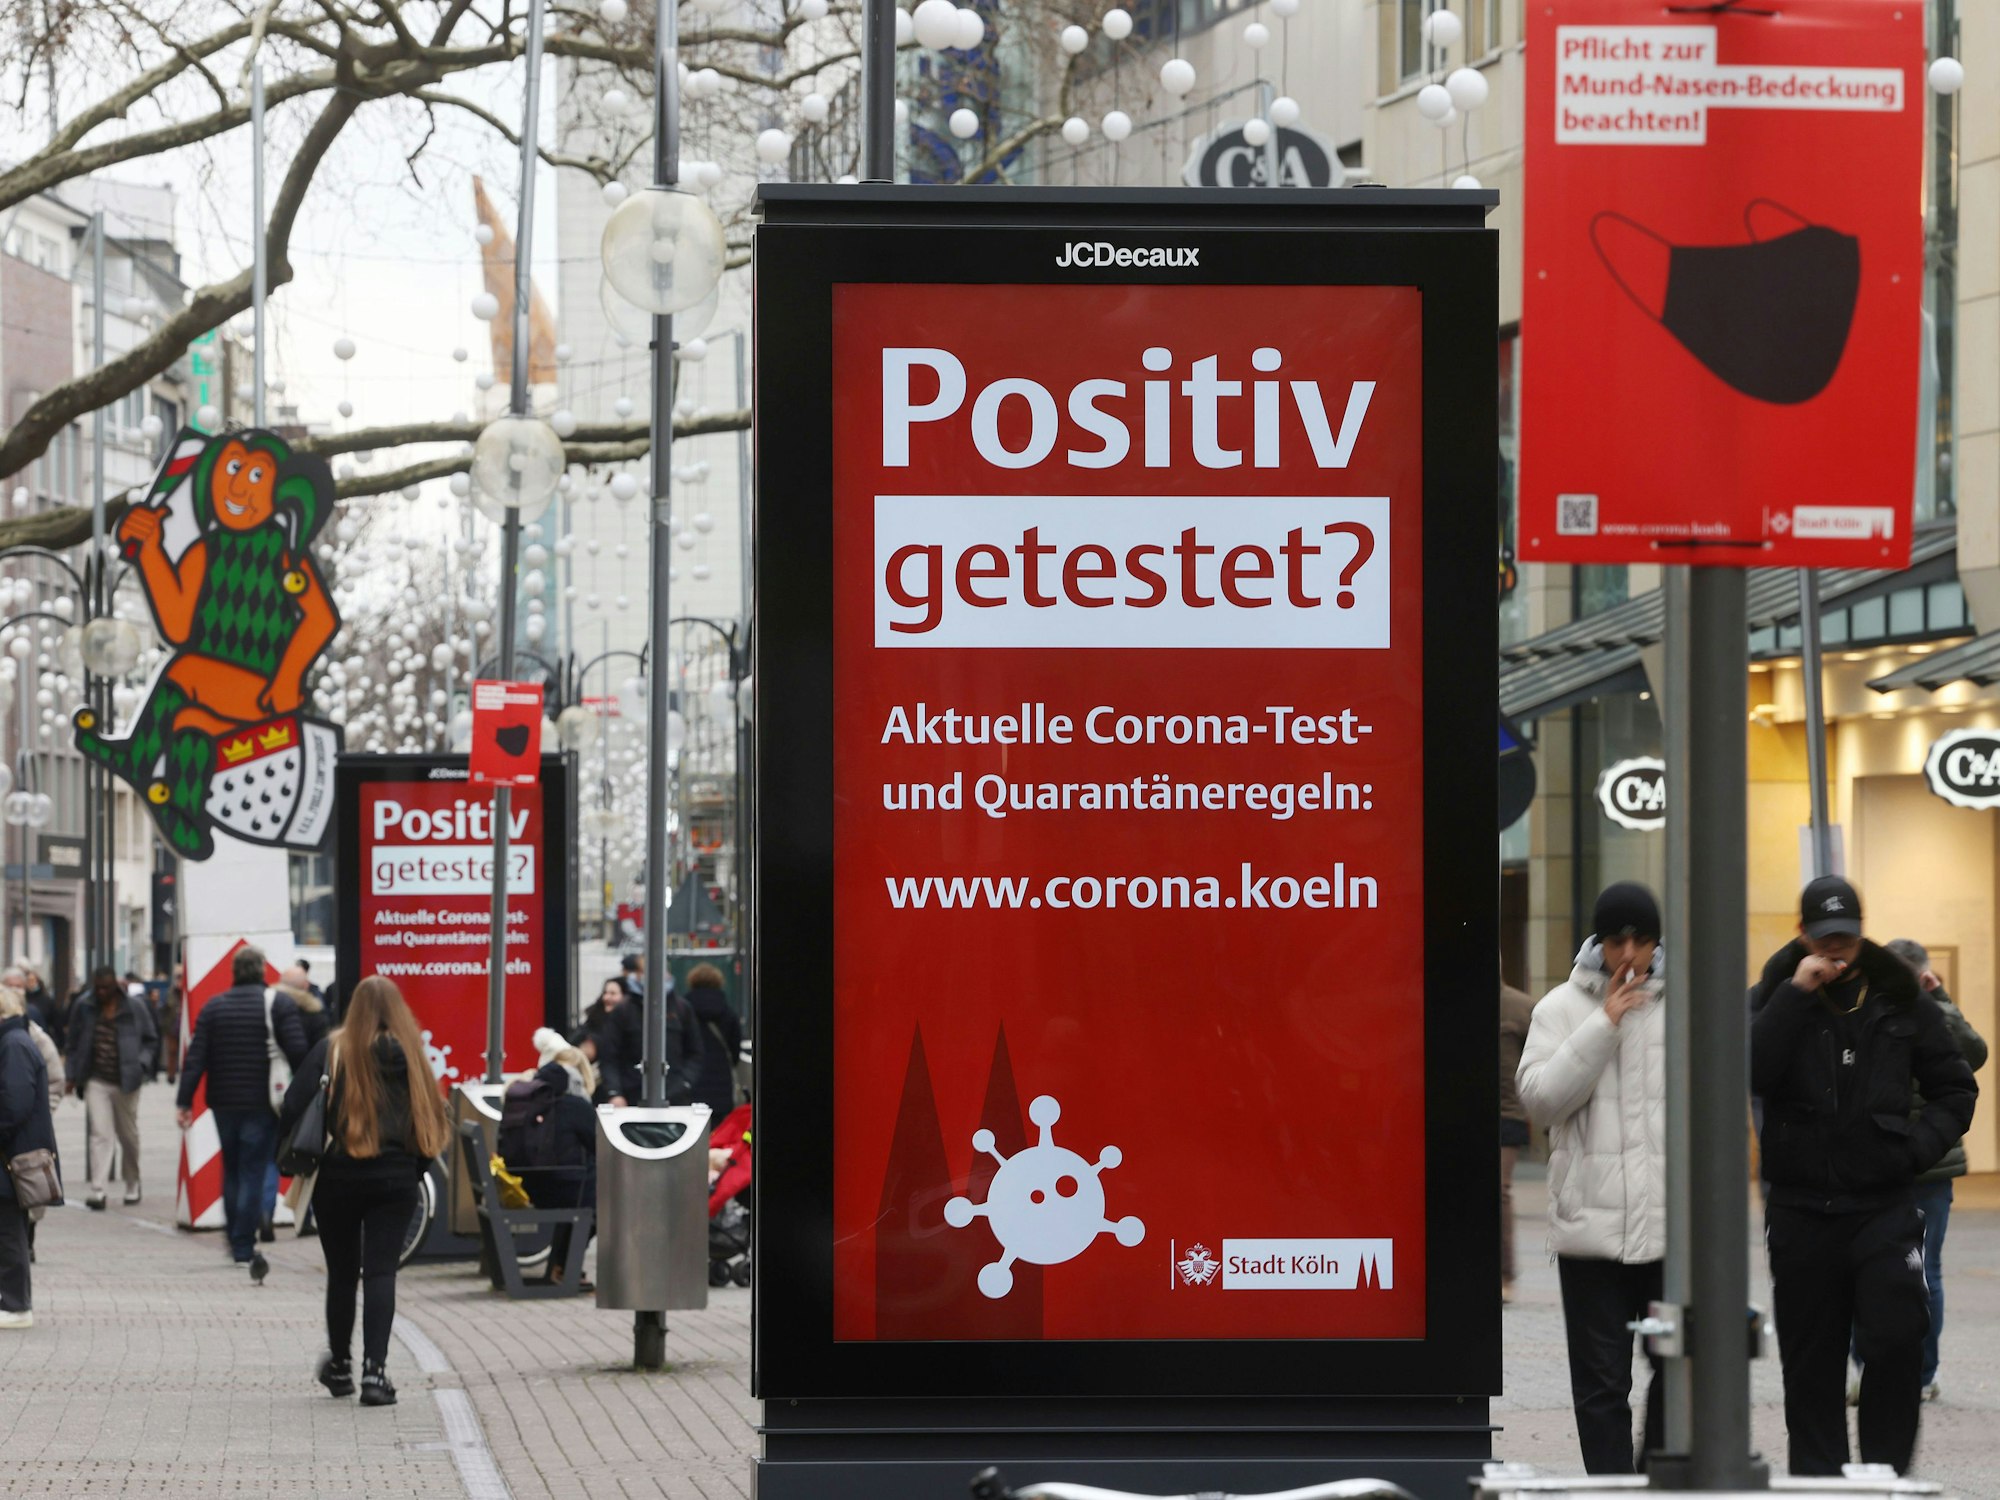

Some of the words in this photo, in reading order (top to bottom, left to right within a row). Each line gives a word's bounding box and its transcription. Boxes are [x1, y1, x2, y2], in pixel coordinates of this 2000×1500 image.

[1563, 38, 1652, 60] Pflicht
[1662, 42, 1704, 60] zur
[1563, 73, 1896, 106] Mund-Nasen-Bedeckung
[1563, 108, 1700, 131] beachten!
[1215, 146, 1313, 188] C&A
[1055, 241, 1200, 268] JCDecaux
[882, 346, 1377, 470] Positiv
[885, 521, 1375, 634] getestet?
[881, 702, 1074, 745] Aktuelle
[1084, 705, 1373, 745] Corona-Test-
[883, 771, 963, 810] und
[974, 771, 1373, 820] Quarantäneregeln:
[374, 799, 529, 840] Positiv
[377, 855, 528, 889] geteste?
[886, 862, 1378, 909] www.corona.koeln
[374, 909, 436, 925] Aktuelle
[375, 930, 402, 945] und
[1228, 1254, 1286, 1275] Stadt
[1291, 1254, 1339, 1275] Köln
